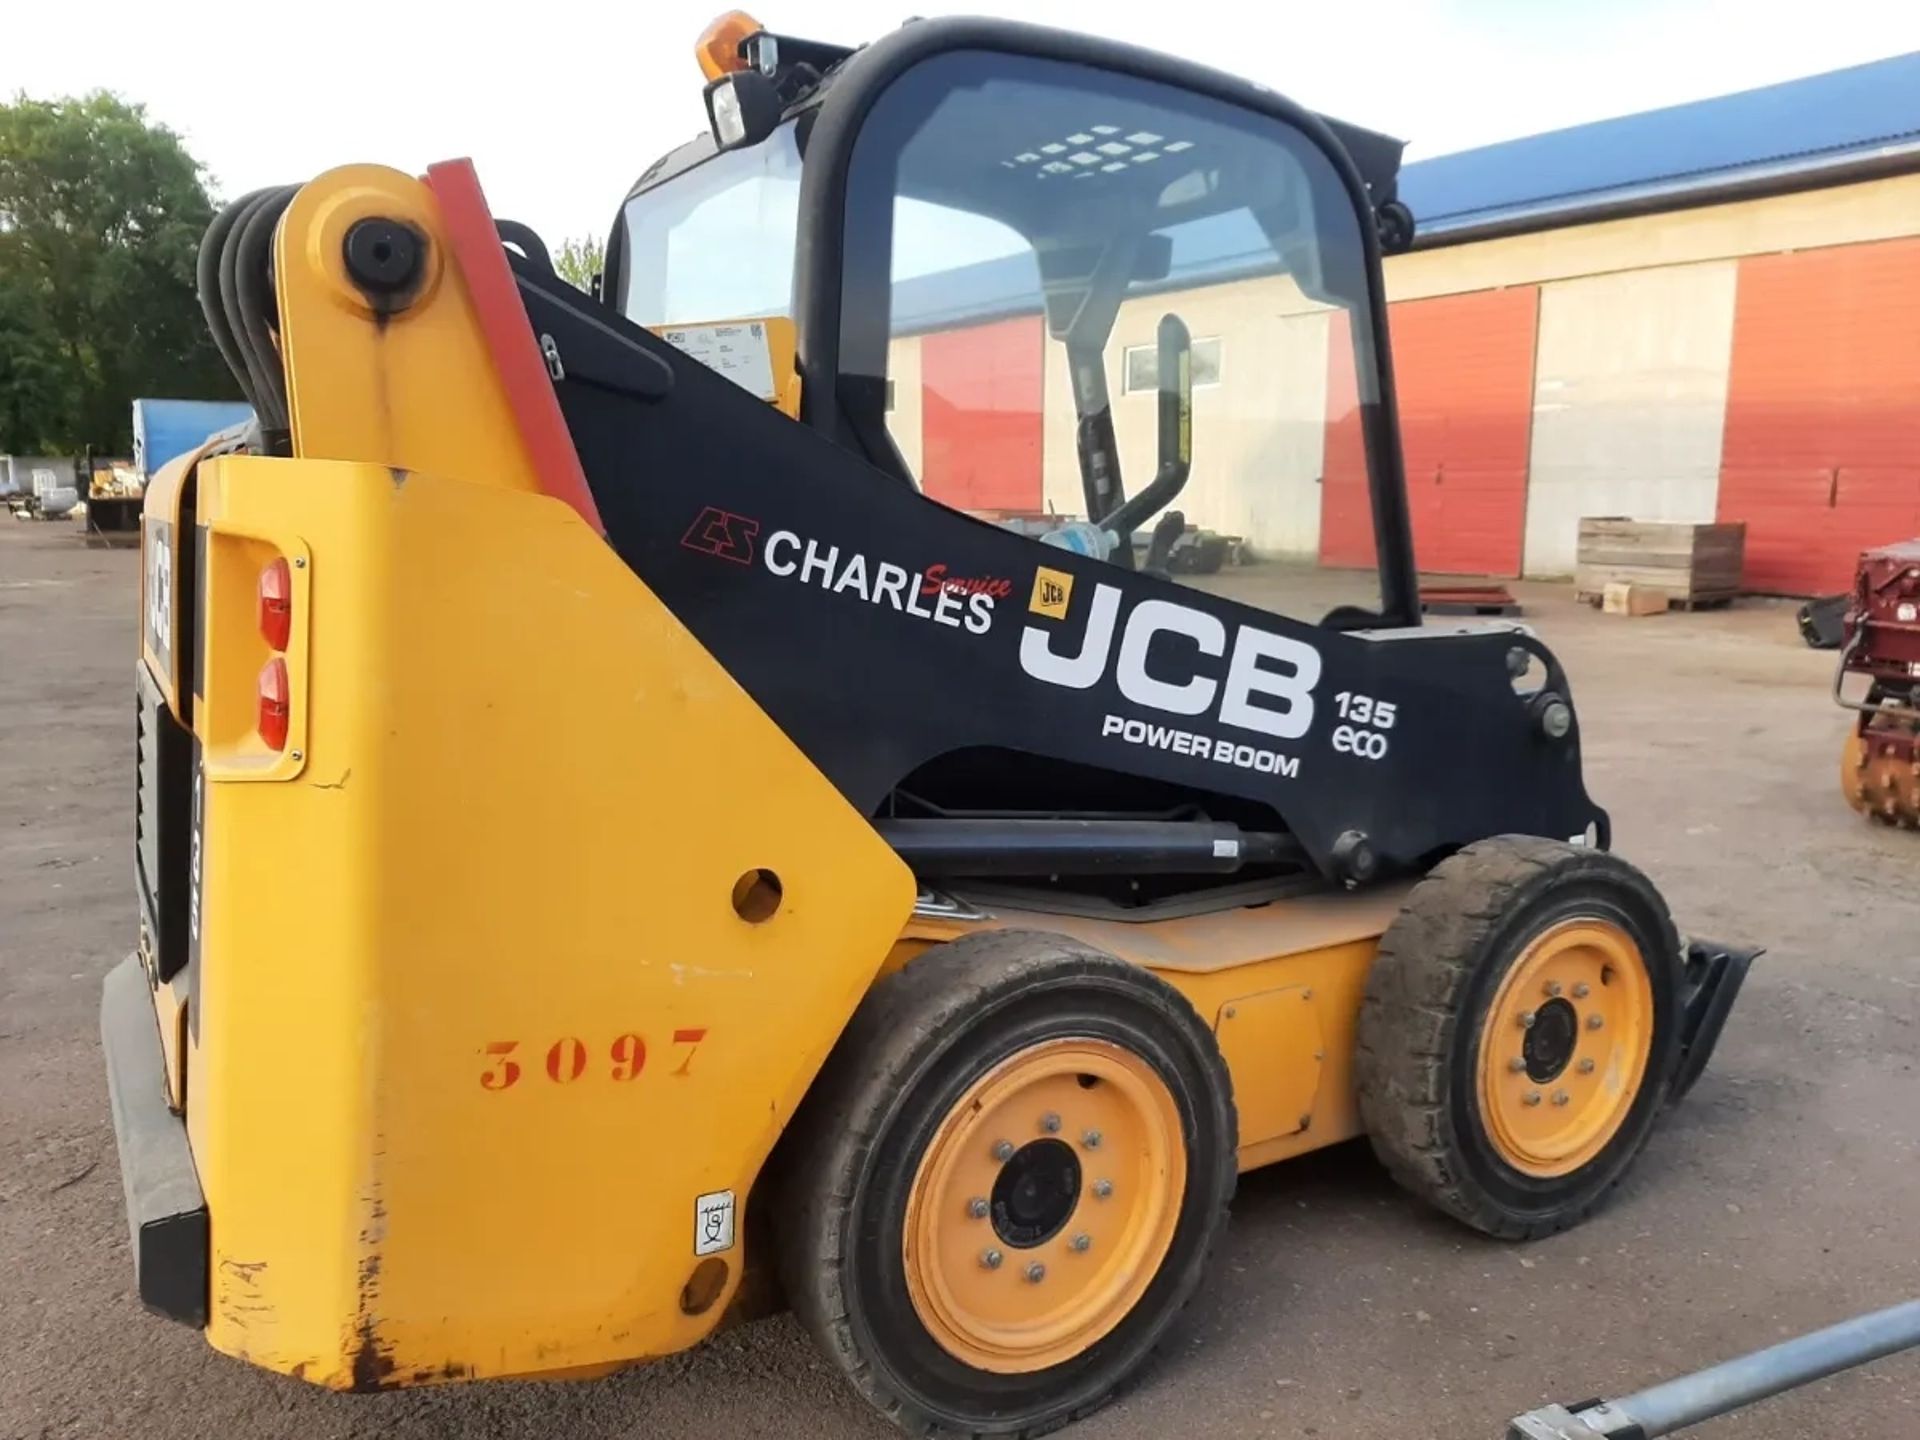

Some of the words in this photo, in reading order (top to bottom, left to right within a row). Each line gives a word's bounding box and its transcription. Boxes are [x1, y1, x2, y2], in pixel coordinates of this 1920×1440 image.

[763, 530, 995, 634] CHARLES
[921, 563, 1012, 598] Service
[1019, 582, 1322, 739] JCB
[1334, 690, 1397, 729] 135
[1331, 723, 1388, 760] eco
[479, 1028, 708, 1091] 3097
